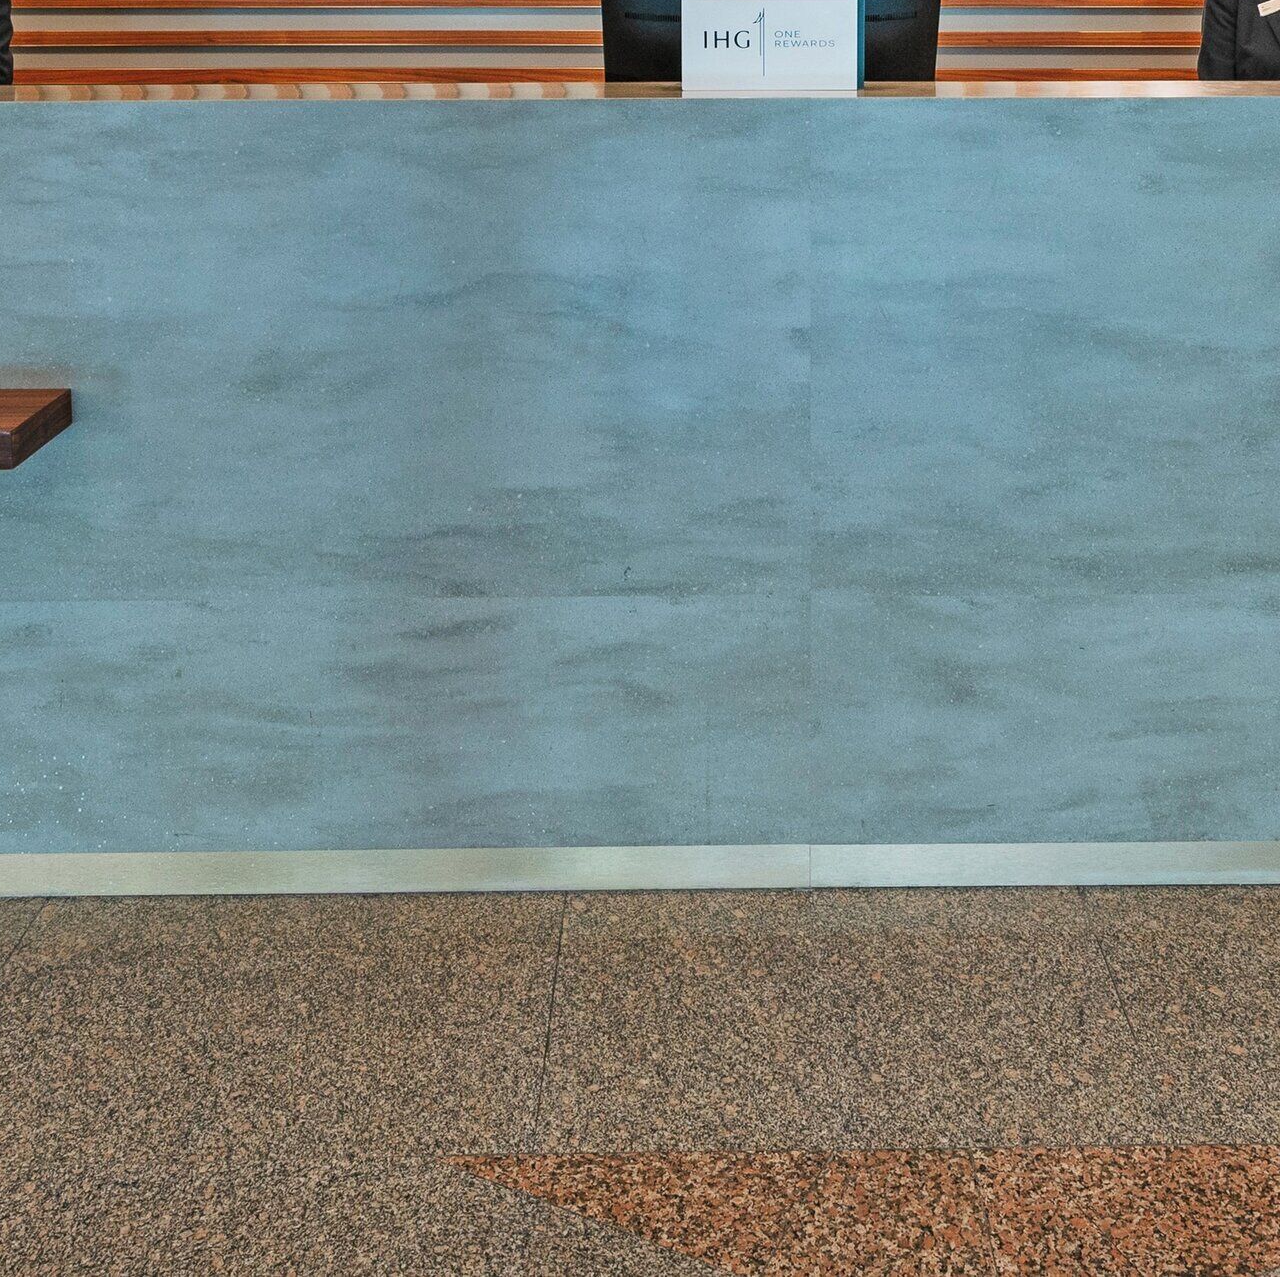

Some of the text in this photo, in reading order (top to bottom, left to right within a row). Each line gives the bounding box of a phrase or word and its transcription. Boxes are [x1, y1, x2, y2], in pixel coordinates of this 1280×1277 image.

[774, 30, 801, 38] ONE
[703, 30, 751, 49] IHG
[774, 40, 836, 48] REWARDS
